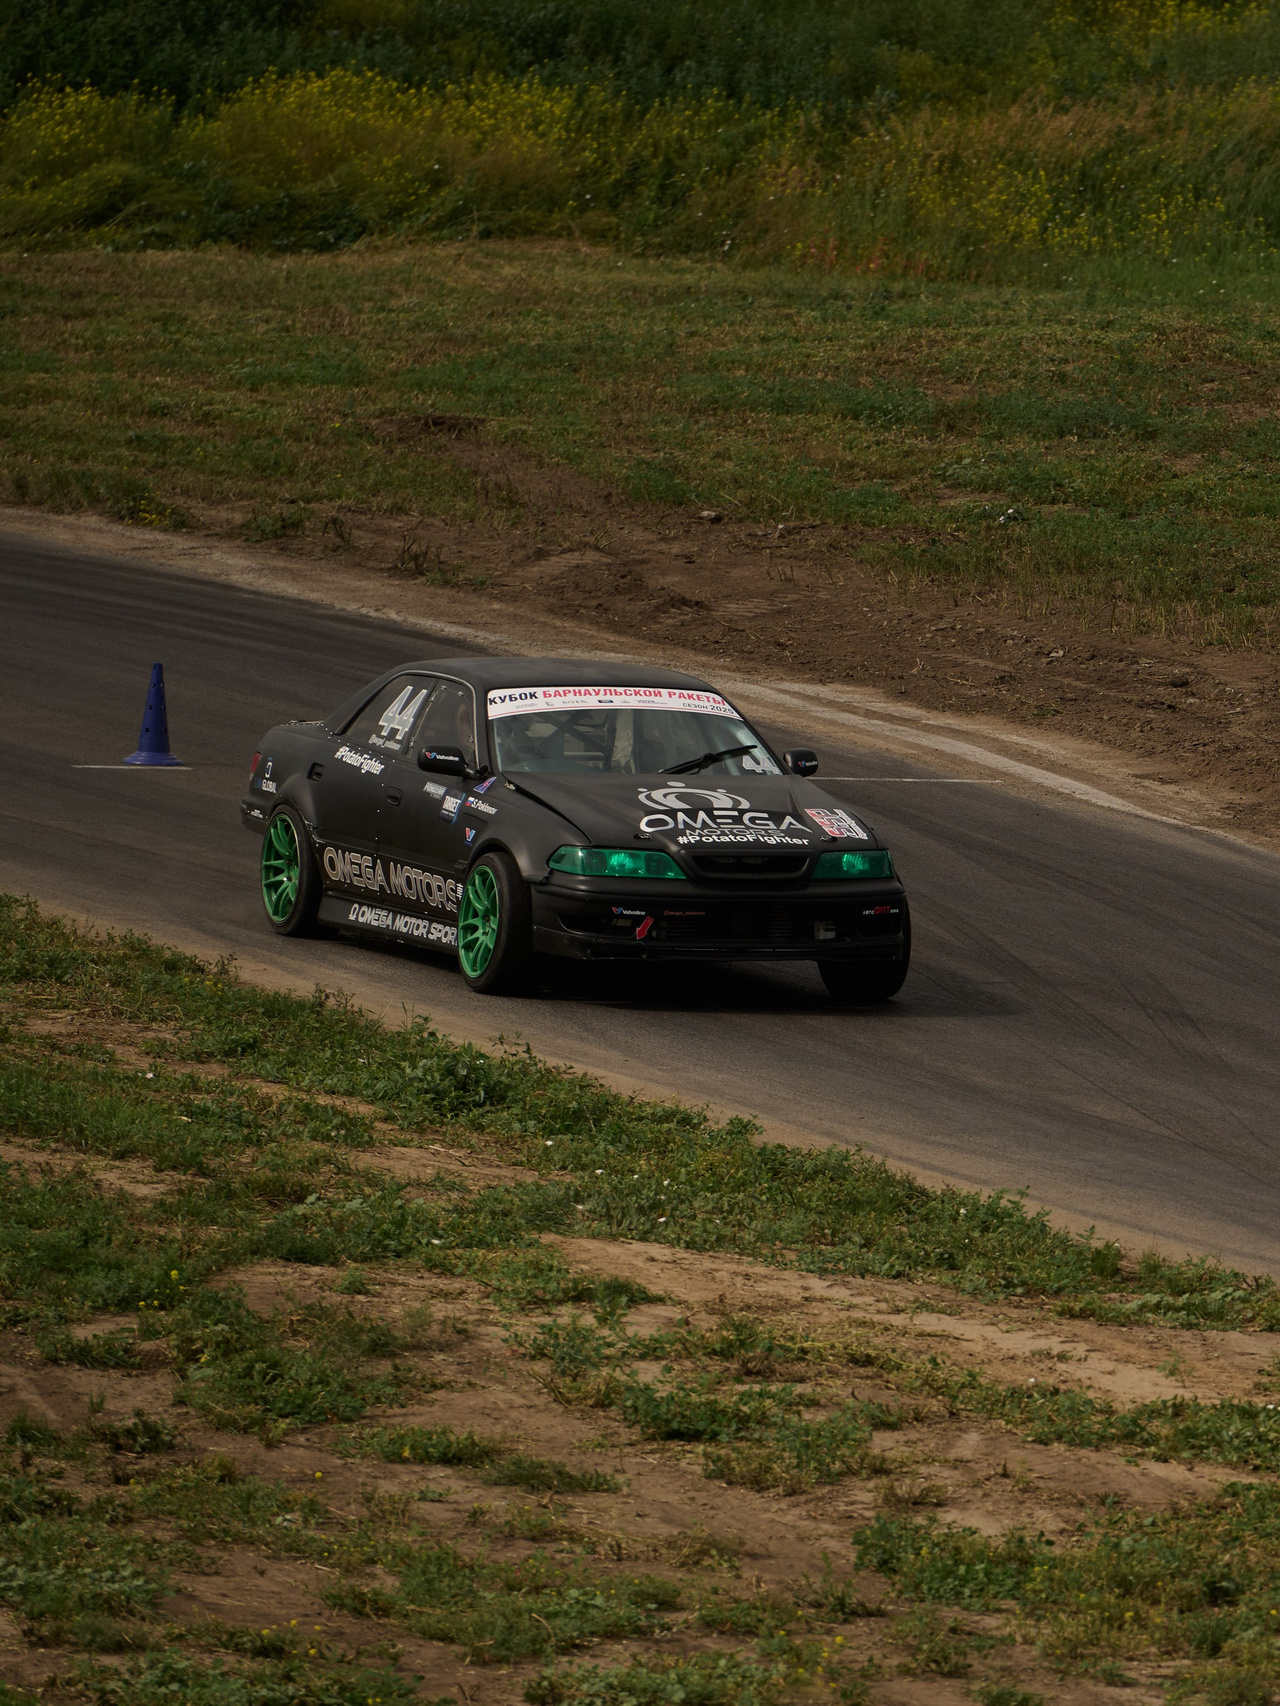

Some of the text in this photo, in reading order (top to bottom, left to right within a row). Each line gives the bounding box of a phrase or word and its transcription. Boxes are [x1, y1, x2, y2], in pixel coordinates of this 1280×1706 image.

[488, 691, 539, 706] КУБОК
[542, 688, 663, 699] БАРНАУЛЬСКОЙ
[668, 691, 726, 706] РАКЕТЫ
[378, 685, 428, 740] 44
[682, 702, 735, 715] СЕЗОН 2025
[334, 745, 385, 775] #PotatoFighter
[435, 753, 460, 762] Valvoline
[742, 754, 780, 775] 44
[639, 810, 813, 834] OMEGA
[676, 834, 810, 846] #PotatoFighter
[685, 829, 785, 837] MOTORS
[323, 846, 458, 913] OMEGA MOTORS
[358, 905, 458, 946] OMEGA MOTOR SPOR
